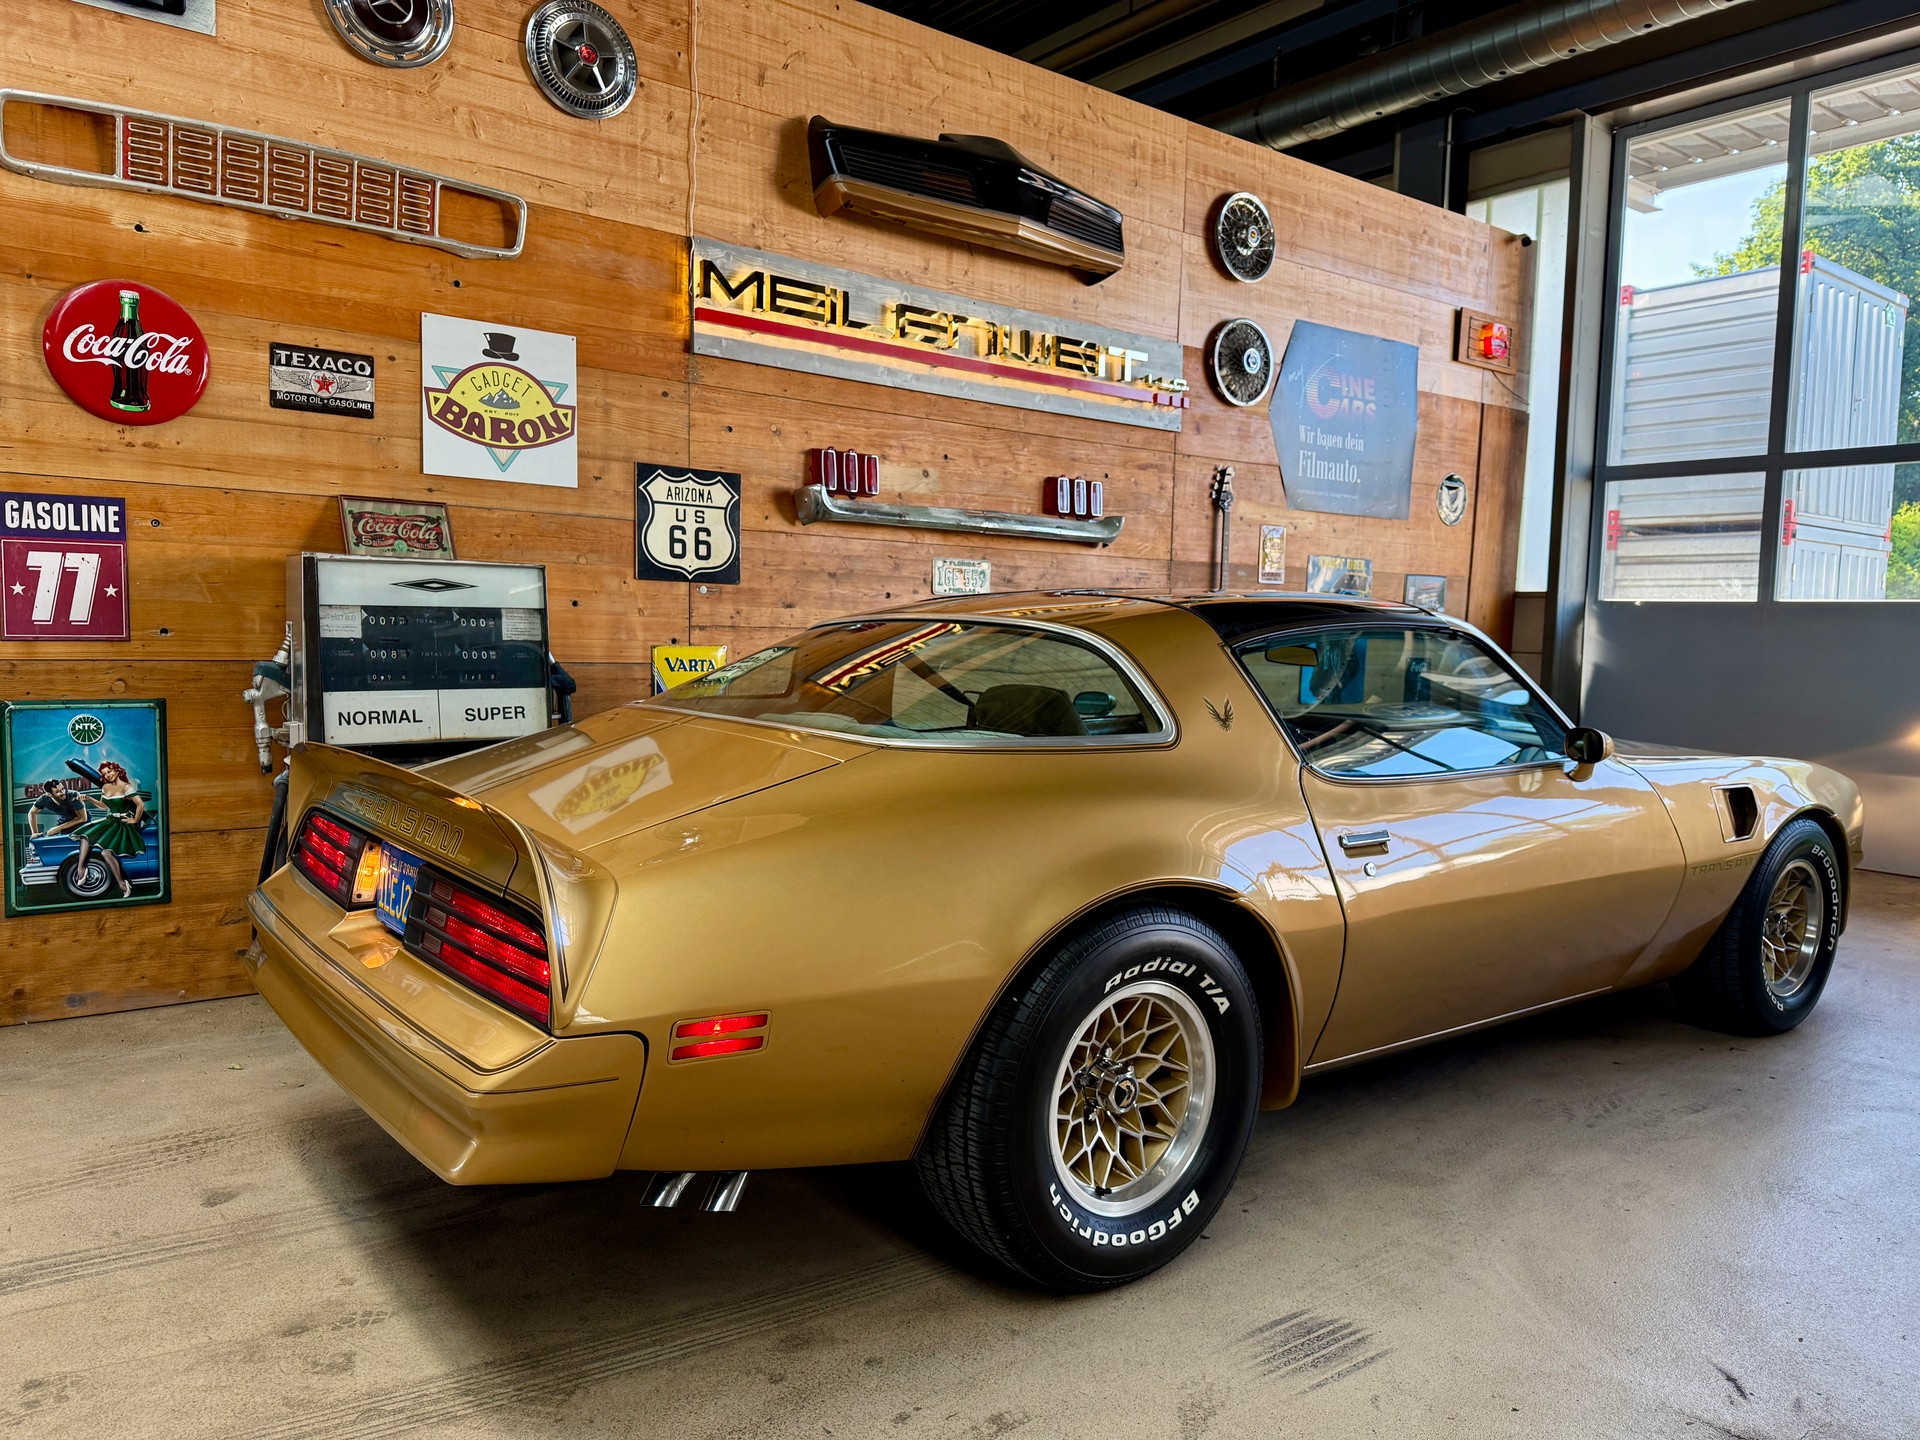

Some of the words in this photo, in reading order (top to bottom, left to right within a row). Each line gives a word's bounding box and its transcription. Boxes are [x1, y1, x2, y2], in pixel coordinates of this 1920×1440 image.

[63, 324, 194, 375] Coca-Cola
[274, 349, 371, 376] TEXACO
[470, 370, 533, 397] GADGET
[276, 391, 307, 403] MOTOR
[309, 396, 323, 405] OIL
[434, 395, 570, 444] BARON
[1298, 425, 1315, 444] Wir
[1317, 428, 1343, 450] bauen
[1345, 432, 1364, 452] dein
[1298, 449, 1361, 484] Filmauto.
[666, 486, 713, 504] ARIZONA
[5, 500, 120, 533] GASOLINE
[358, 518, 438, 540] Coca-Cola
[669, 525, 711, 560] 66
[26, 551, 101, 625] 77
[664, 657, 717, 672] VARTA
[75, 723, 98, 731] NTK
[338, 709, 423, 726] NORMAL
[464, 705, 526, 722] SUPER
[415, 811, 465, 857] AM
[1690, 860, 1733, 877] TRANS
[1811, 844, 1840, 952] BFGoodrich
[1103, 956, 1197, 994] Radial
[1049, 1182, 1200, 1247] BFGoodrich
